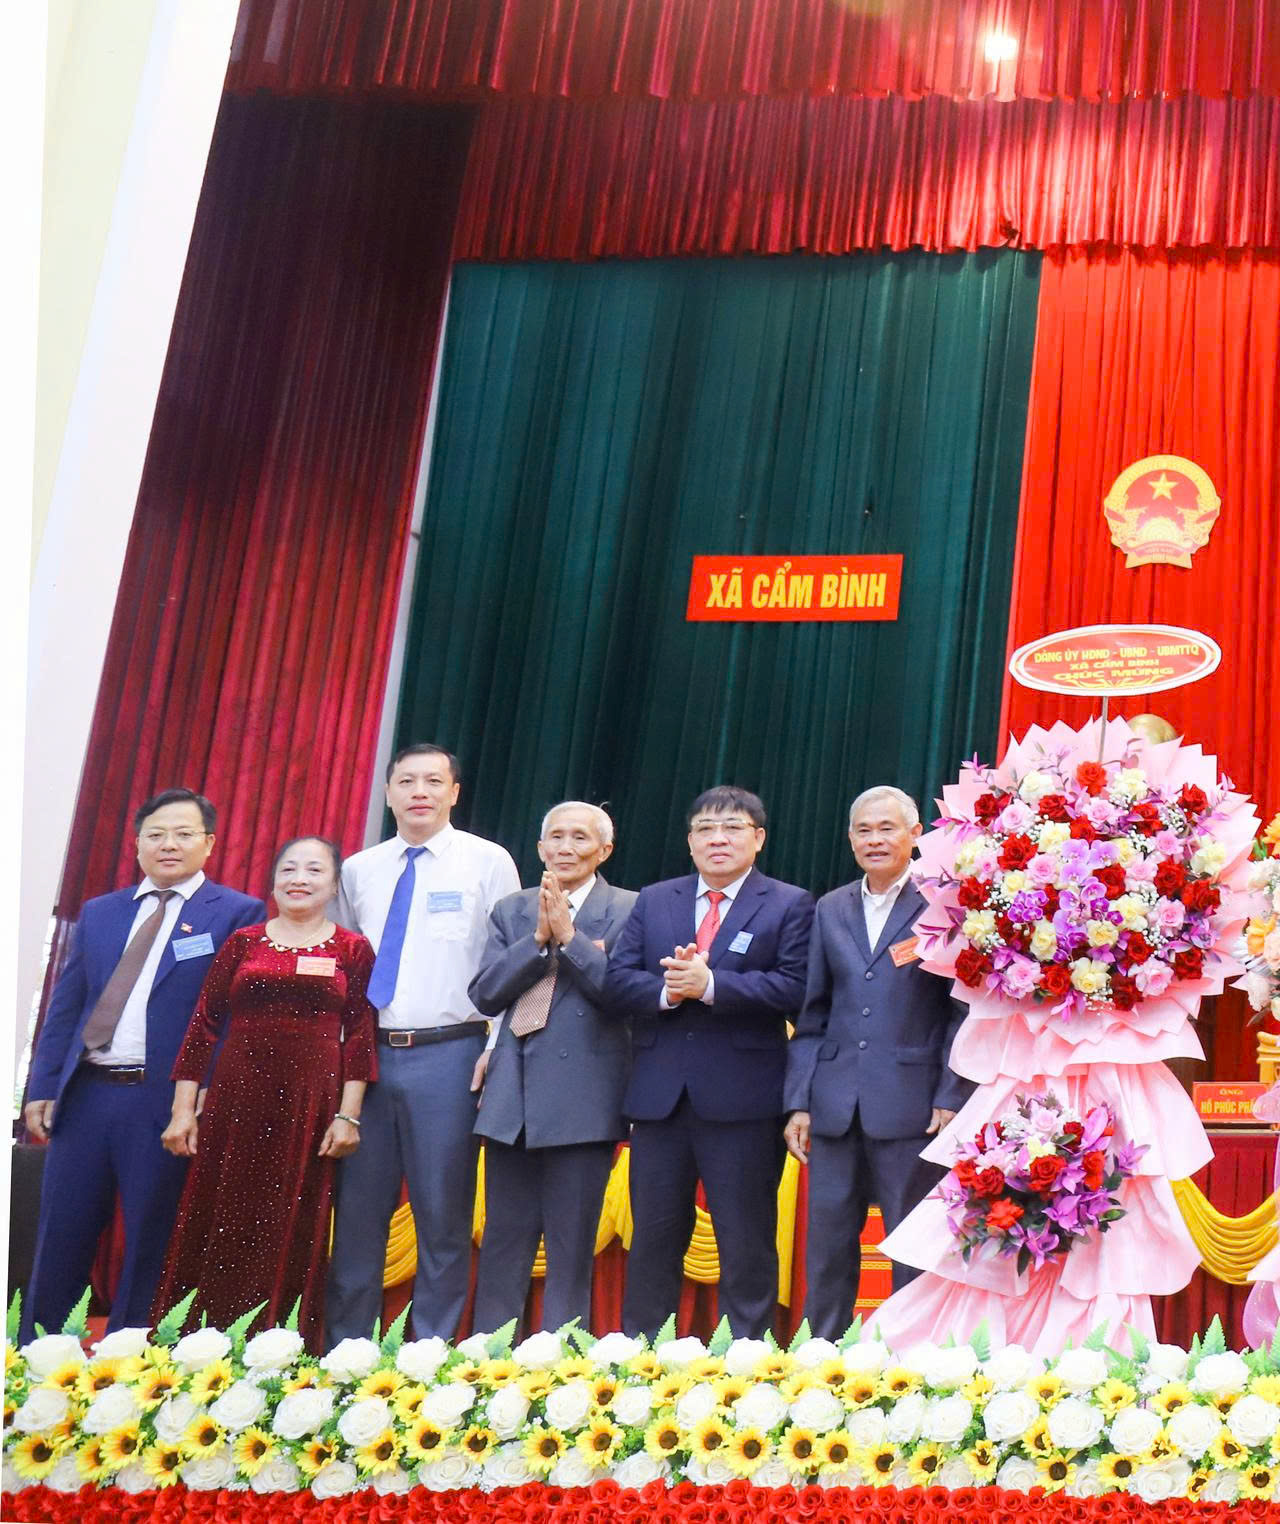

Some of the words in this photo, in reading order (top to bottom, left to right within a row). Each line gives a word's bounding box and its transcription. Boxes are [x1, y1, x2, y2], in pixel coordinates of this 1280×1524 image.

[706, 567, 743, 609] XÃ
[751, 561, 814, 609] CẨM
[820, 566, 887, 609] BÌNH
